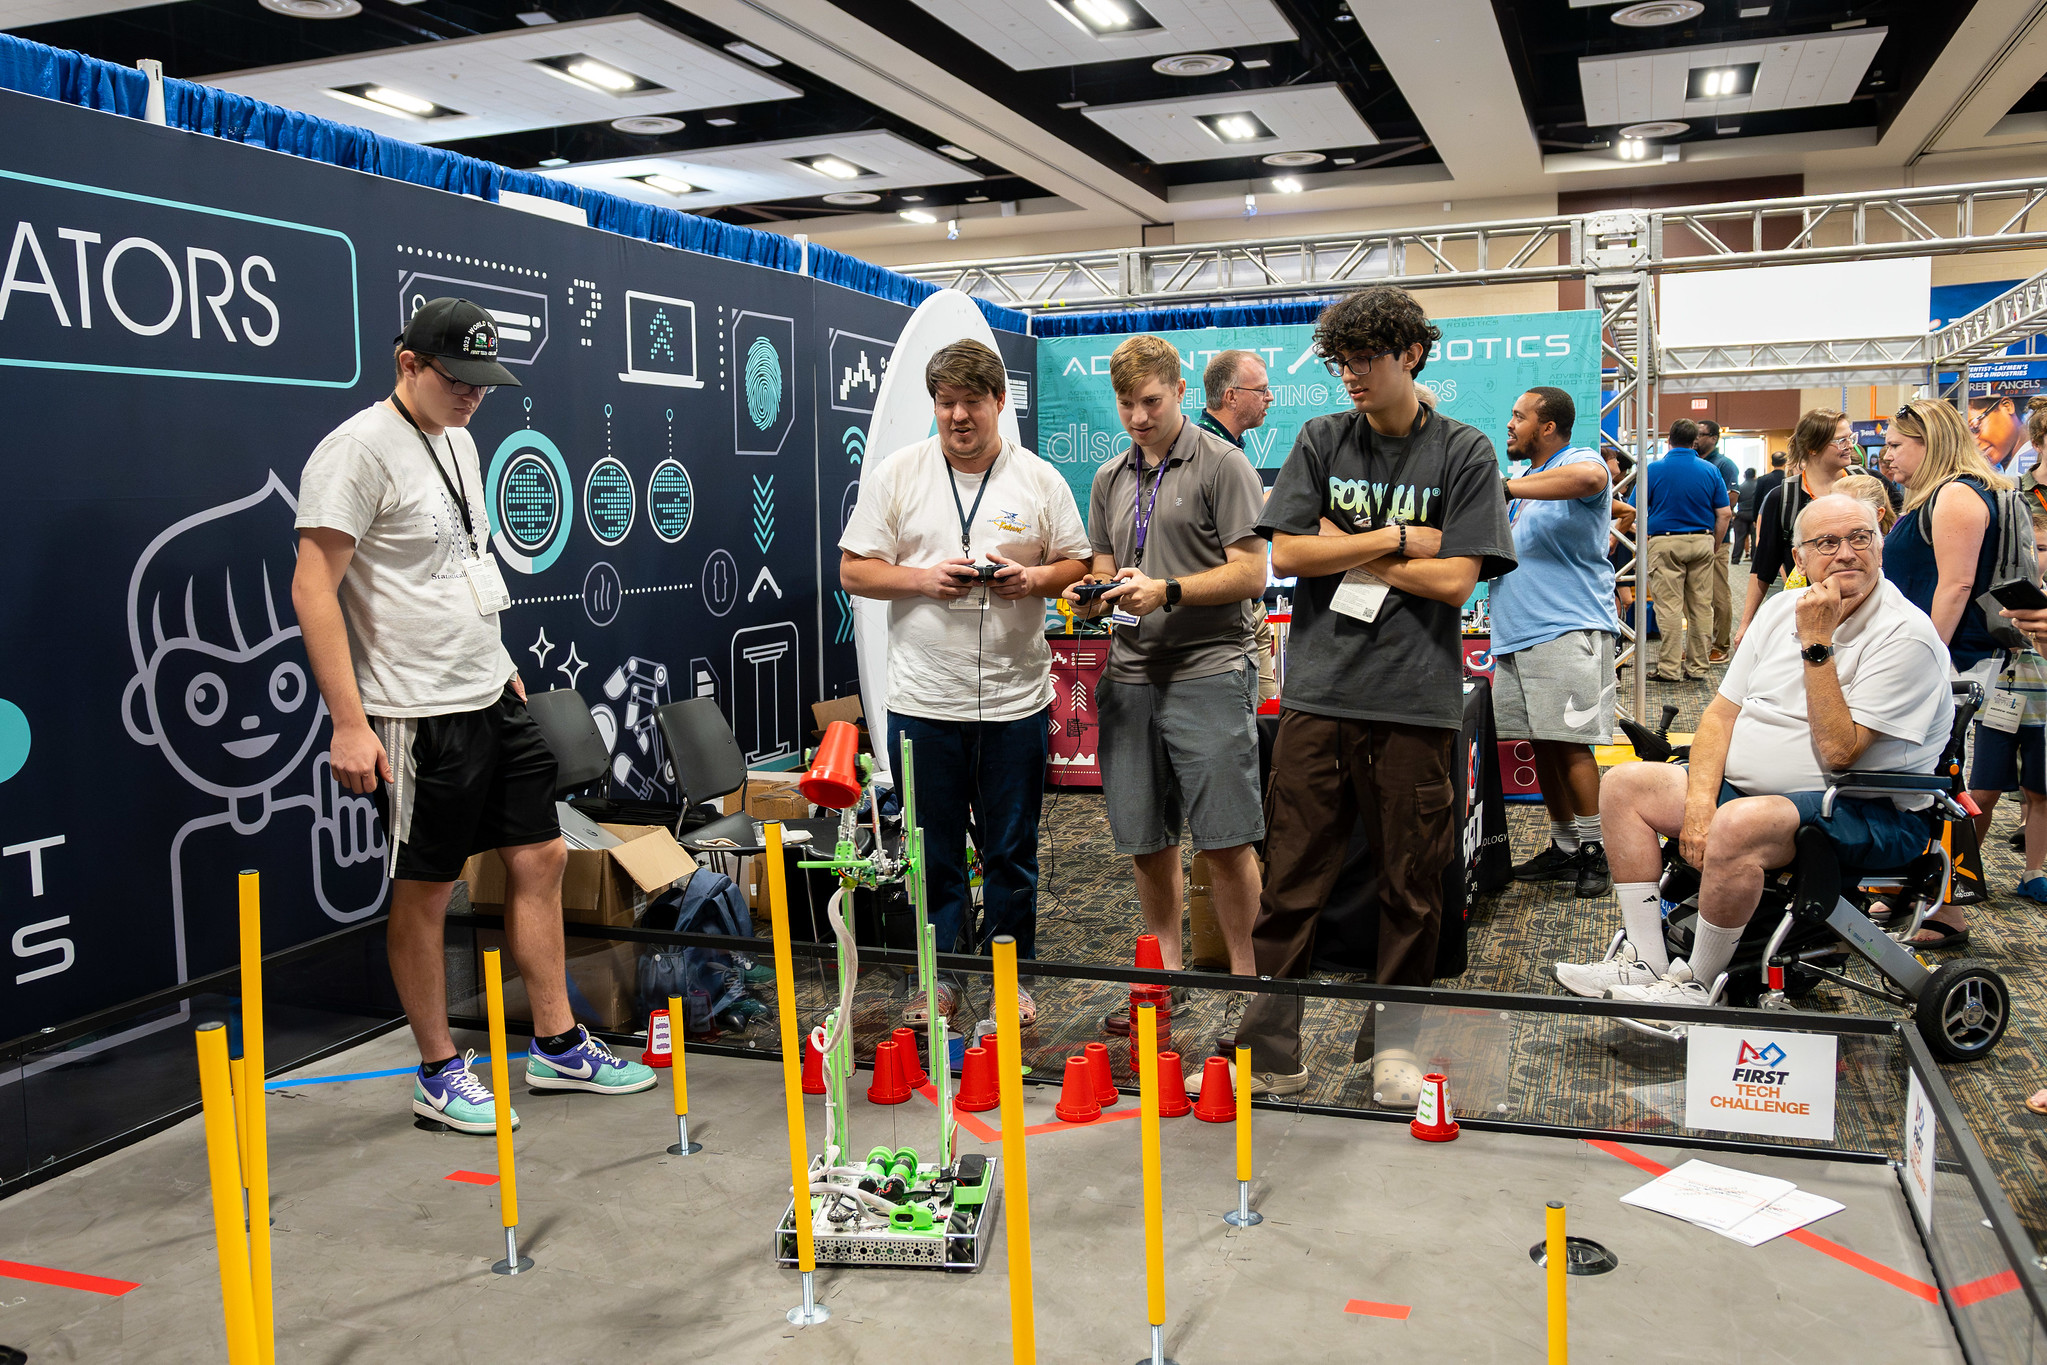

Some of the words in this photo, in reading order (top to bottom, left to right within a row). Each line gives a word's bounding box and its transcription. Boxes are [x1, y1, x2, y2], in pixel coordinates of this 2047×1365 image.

[468, 320, 487, 335] WORLD
[1998, 379, 2040, 390] ANGELS
[2, 834, 66, 897] T
[11, 914, 75, 985] S
[1732, 1068, 1789, 1085] FIRST
[1735, 1083, 1780, 1099] TECH
[1710, 1095, 1810, 1115] CHALLENGE
